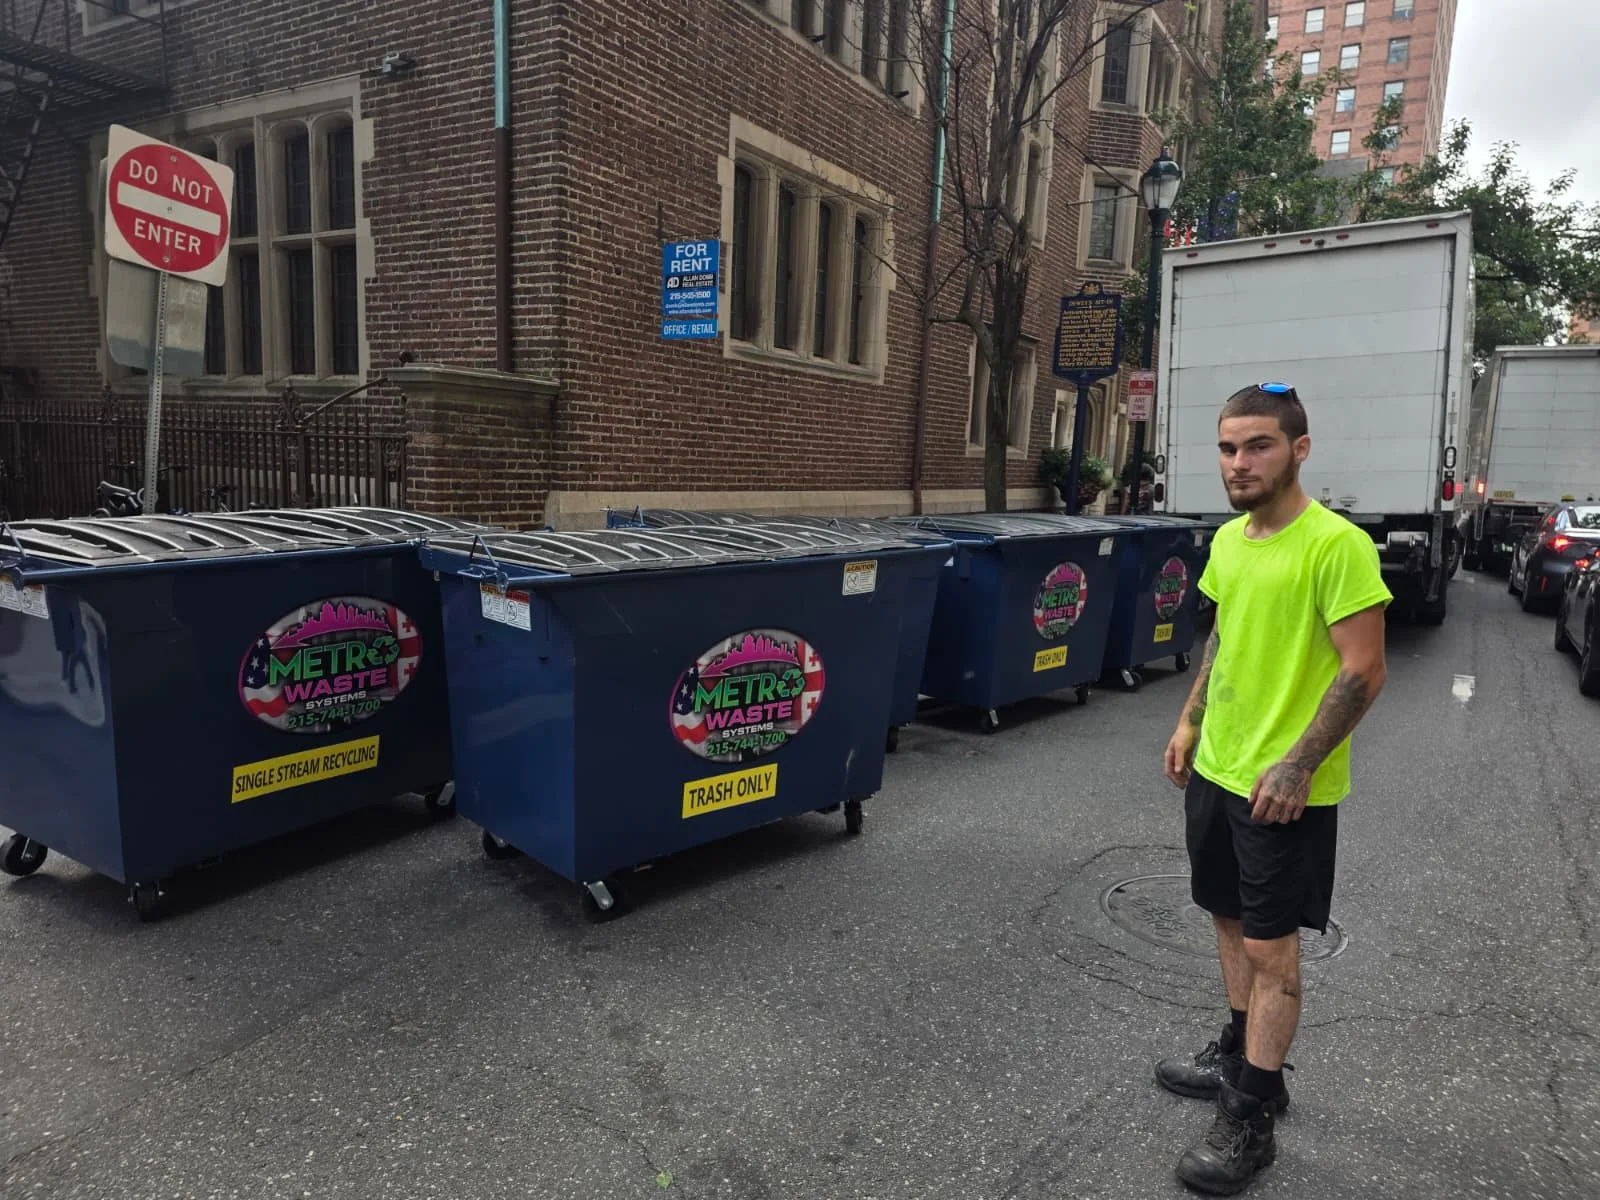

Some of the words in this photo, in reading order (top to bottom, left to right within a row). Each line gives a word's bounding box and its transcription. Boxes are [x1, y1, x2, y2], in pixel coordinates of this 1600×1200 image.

[129, 158, 158, 185] DO
[172, 174, 213, 204] NOT
[134, 217, 201, 255] ENTER
[675, 243, 707, 258] FOR
[671, 257, 712, 273] RENT
[663, 325, 687, 335] OFFICE
[691, 324, 714, 334] RETAIL
[1044, 605, 1074, 621] WASTE
[283, 668, 388, 704] WASTE
[287, 699, 382, 729] 215-744-1700
[305, 690, 367, 711] SYSTEMS
[705, 700, 793, 731] WASTE
[706, 731, 786, 757] 215-744-1700
[722, 722, 774, 739] SYSTEMS
[234, 767, 274, 794] SINGLE
[276, 757, 320, 781] STREAM
[322, 744, 376, 773] RECYCLING
[688, 779, 733, 809] TRASH
[737, 771, 772, 797] ONLY
